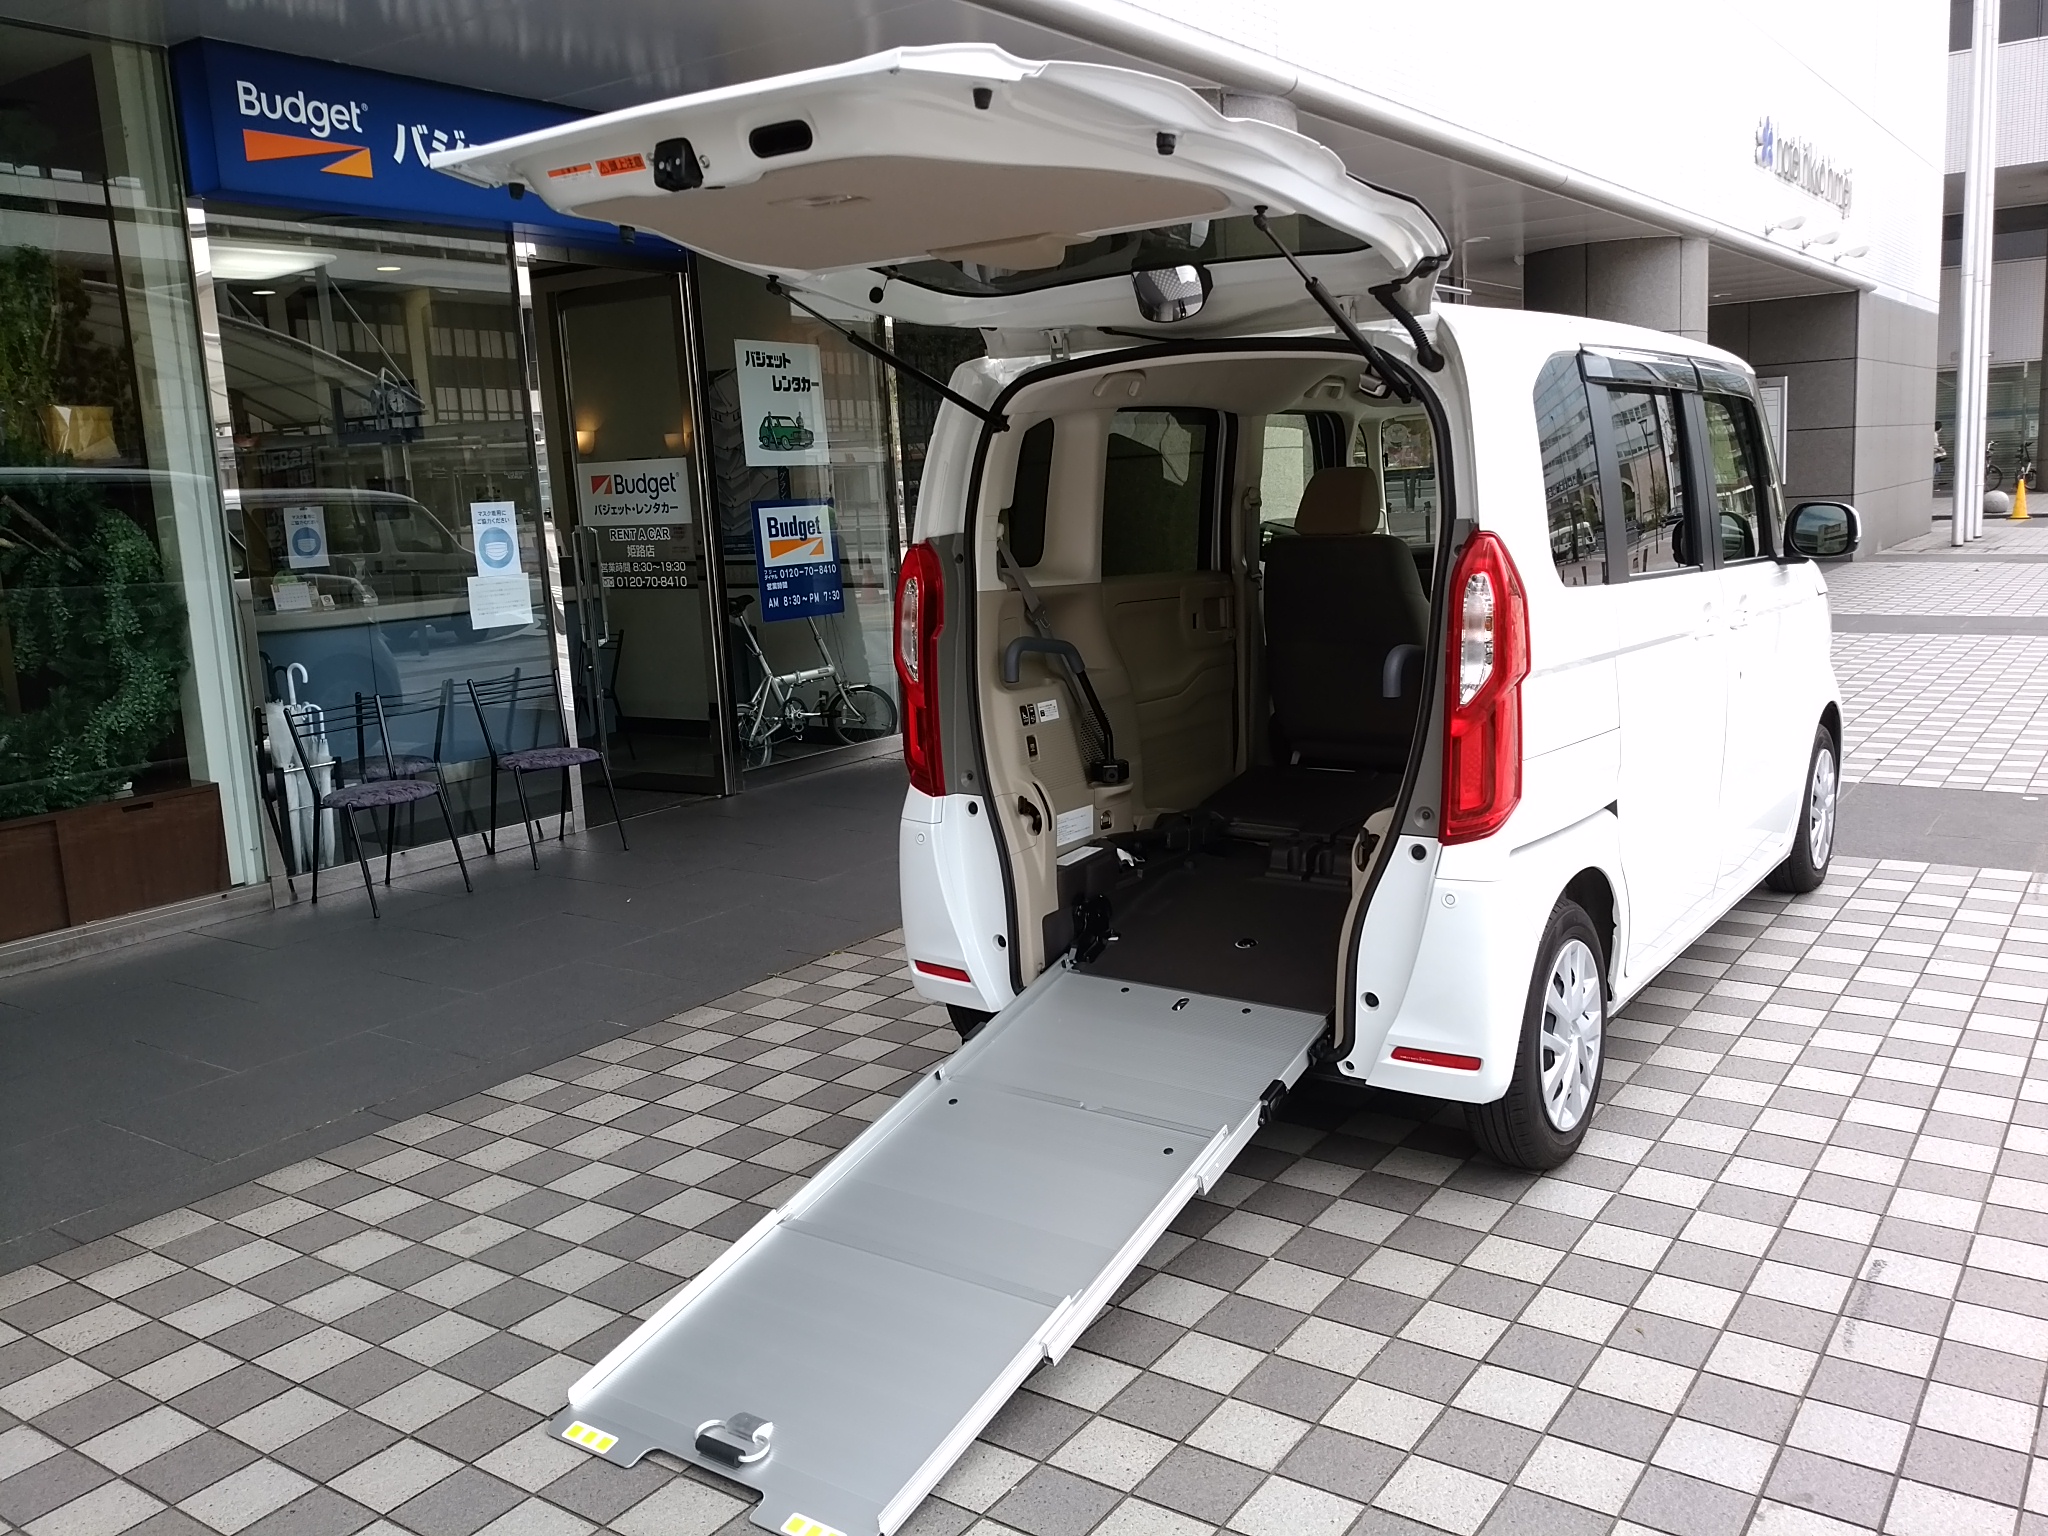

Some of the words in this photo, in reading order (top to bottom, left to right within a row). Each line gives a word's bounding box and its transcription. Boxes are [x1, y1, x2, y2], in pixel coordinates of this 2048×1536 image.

[236, 80, 363, 138] Budget
[745, 350, 792, 369] バジェット
[771, 374, 820, 393] レンタカー
[613, 472, 677, 500] Budget
[594, 502, 679, 516] バジェット・レンタカー
[609, 528, 636, 541] RENT
[637, 528, 648, 541] A
[647, 527, 671, 541] CAR
[766, 515, 822, 542] Budget
[626, 544, 655, 558] 姫路店
[779, 564, 837, 579] 0120-70-8410
[616, 576, 688, 587] 0120-70-8410
[768, 597, 779, 609] AM
[823, 590, 840, 602] 7:30
